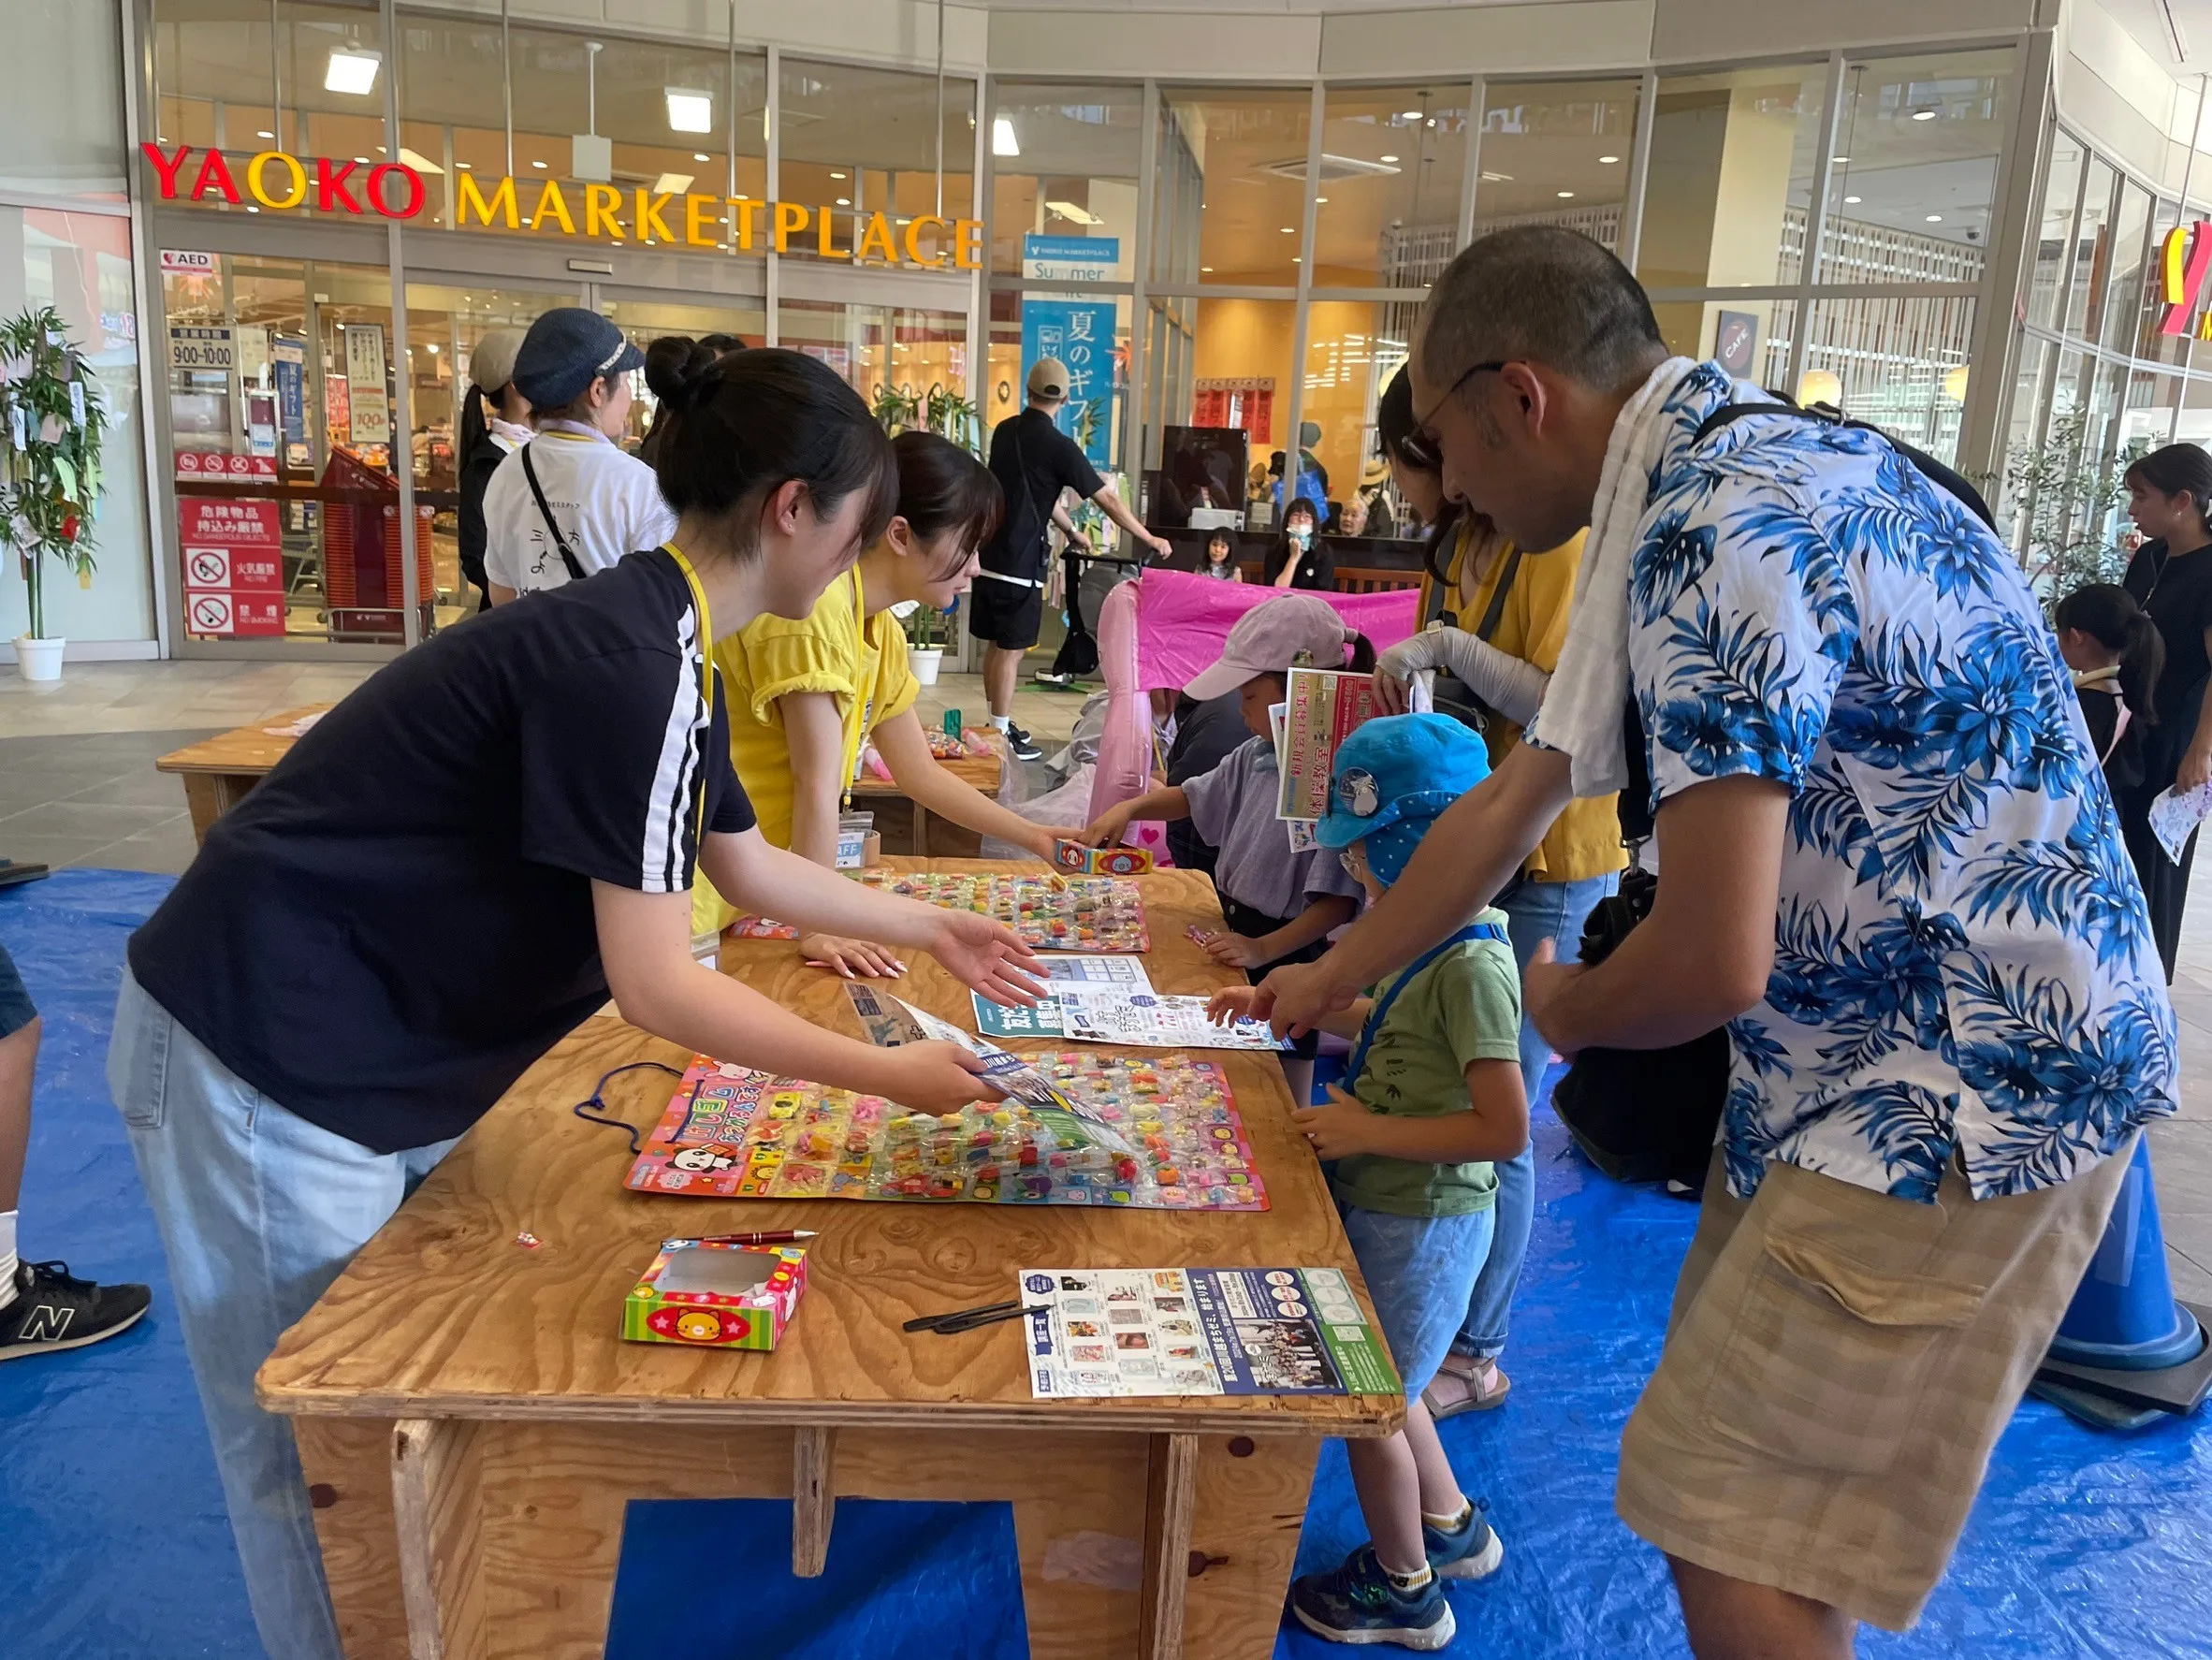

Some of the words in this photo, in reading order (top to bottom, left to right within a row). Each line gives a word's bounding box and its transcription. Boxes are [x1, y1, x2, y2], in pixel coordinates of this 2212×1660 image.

[140, 142, 426, 219] YAOKO
[457, 172, 984, 270] MARKETPLACE
[178, 254, 208, 266] AED
[1724, 328, 1749, 359] CAFE
[200, 505, 259, 519] 危険物品
[196, 520, 265, 534] 持込み厳禁
[236, 562, 276, 575] 火気厳禁
[1309, 746, 1331, 816] 体操教室
[18, 1304, 76, 1342] N
